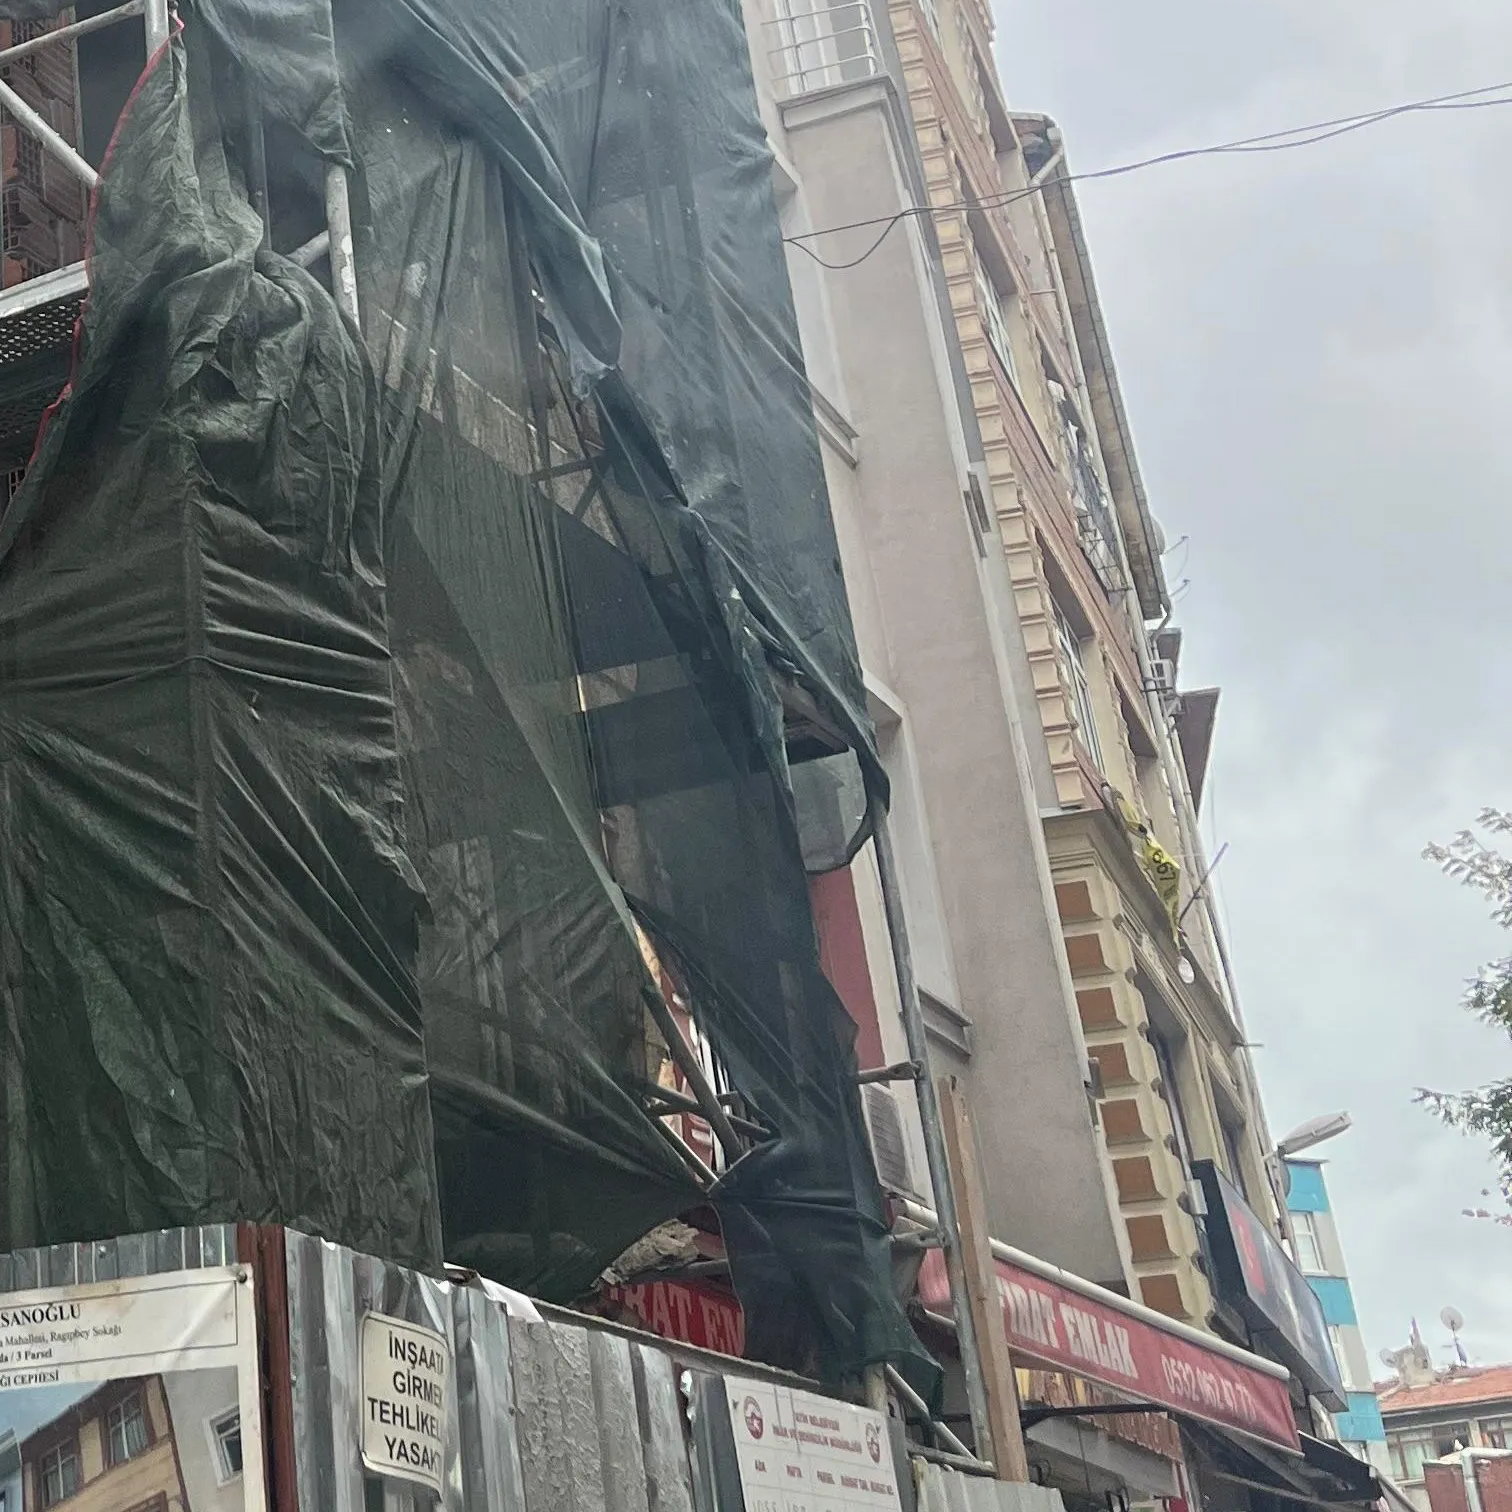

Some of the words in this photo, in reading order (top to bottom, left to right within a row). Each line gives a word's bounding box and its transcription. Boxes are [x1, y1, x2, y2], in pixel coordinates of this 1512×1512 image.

[1058, 1301, 1139, 1379] EMLAK
[16, 1350, 22, 1362] 3
[24, 1347, 53, 1361] Parsel
[13, 1369, 59, 1386] CEPHESİ
